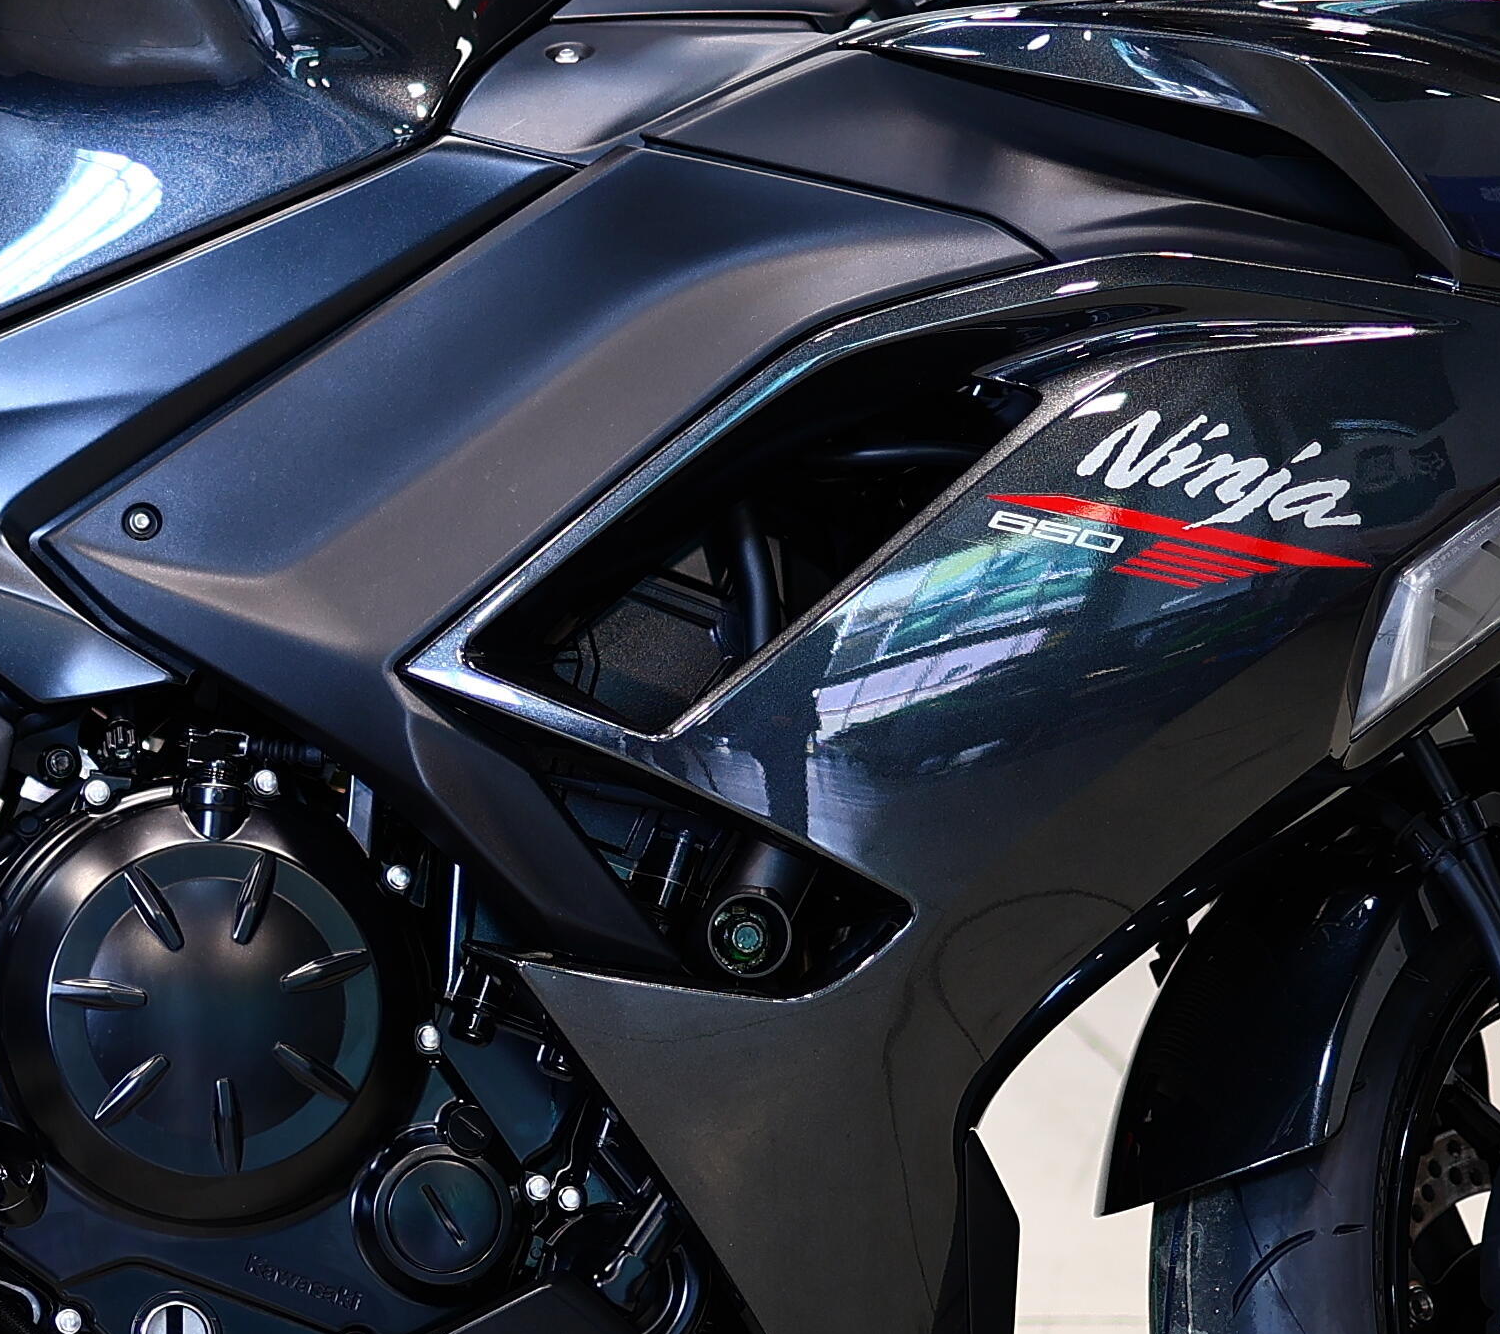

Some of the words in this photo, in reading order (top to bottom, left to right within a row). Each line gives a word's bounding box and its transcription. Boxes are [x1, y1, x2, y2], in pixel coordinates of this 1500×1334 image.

[1076, 410, 1362, 532] Ninja
[987, 509, 1124, 554] 650
[244, 1252, 364, 1312] Kawasaki
